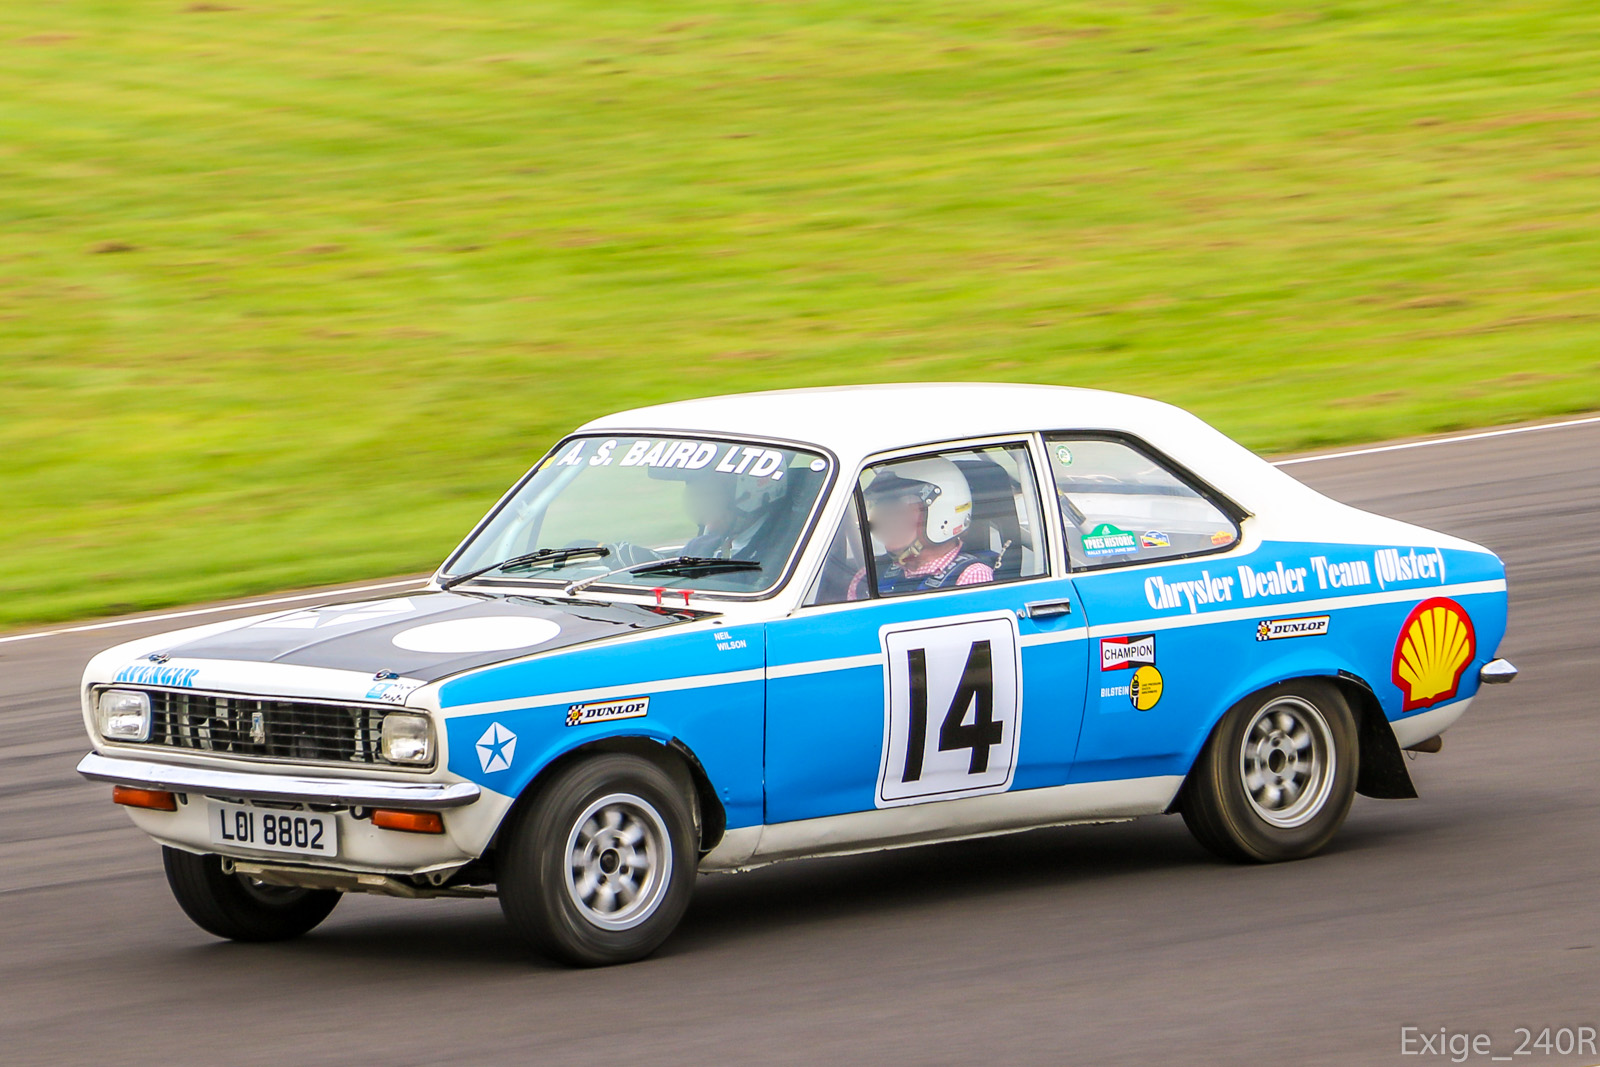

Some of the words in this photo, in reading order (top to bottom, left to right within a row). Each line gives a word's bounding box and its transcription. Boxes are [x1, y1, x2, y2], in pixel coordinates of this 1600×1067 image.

[557, 441, 586, 466] A.
[590, 440, 617, 466] S.
[619, 440, 717, 470] BAIRD
[715, 446, 784, 480] LTD.
[1083, 539, 1105, 550] YPRES
[1105, 535, 1135, 547] HISTORIC
[1144, 570, 1233, 614] Chrysler
[1236, 561, 1307, 599] Dealer
[1310, 555, 1371, 590] Team
[1374, 546, 1446, 591] (Ulster)
[1272, 621, 1325, 634] DUNLOP
[713, 631, 732, 641] NEIL
[716, 639, 747, 651] WILSON
[1104, 644, 1153, 660] CHAMPION
[116, 666, 200, 687] AVENGER
[1100, 685, 1129, 698] BILSTEIN
[585, 703, 645, 718] DUNLOP
[901, 639, 1004, 783] 14
[263, 814, 324, 850] 8802
